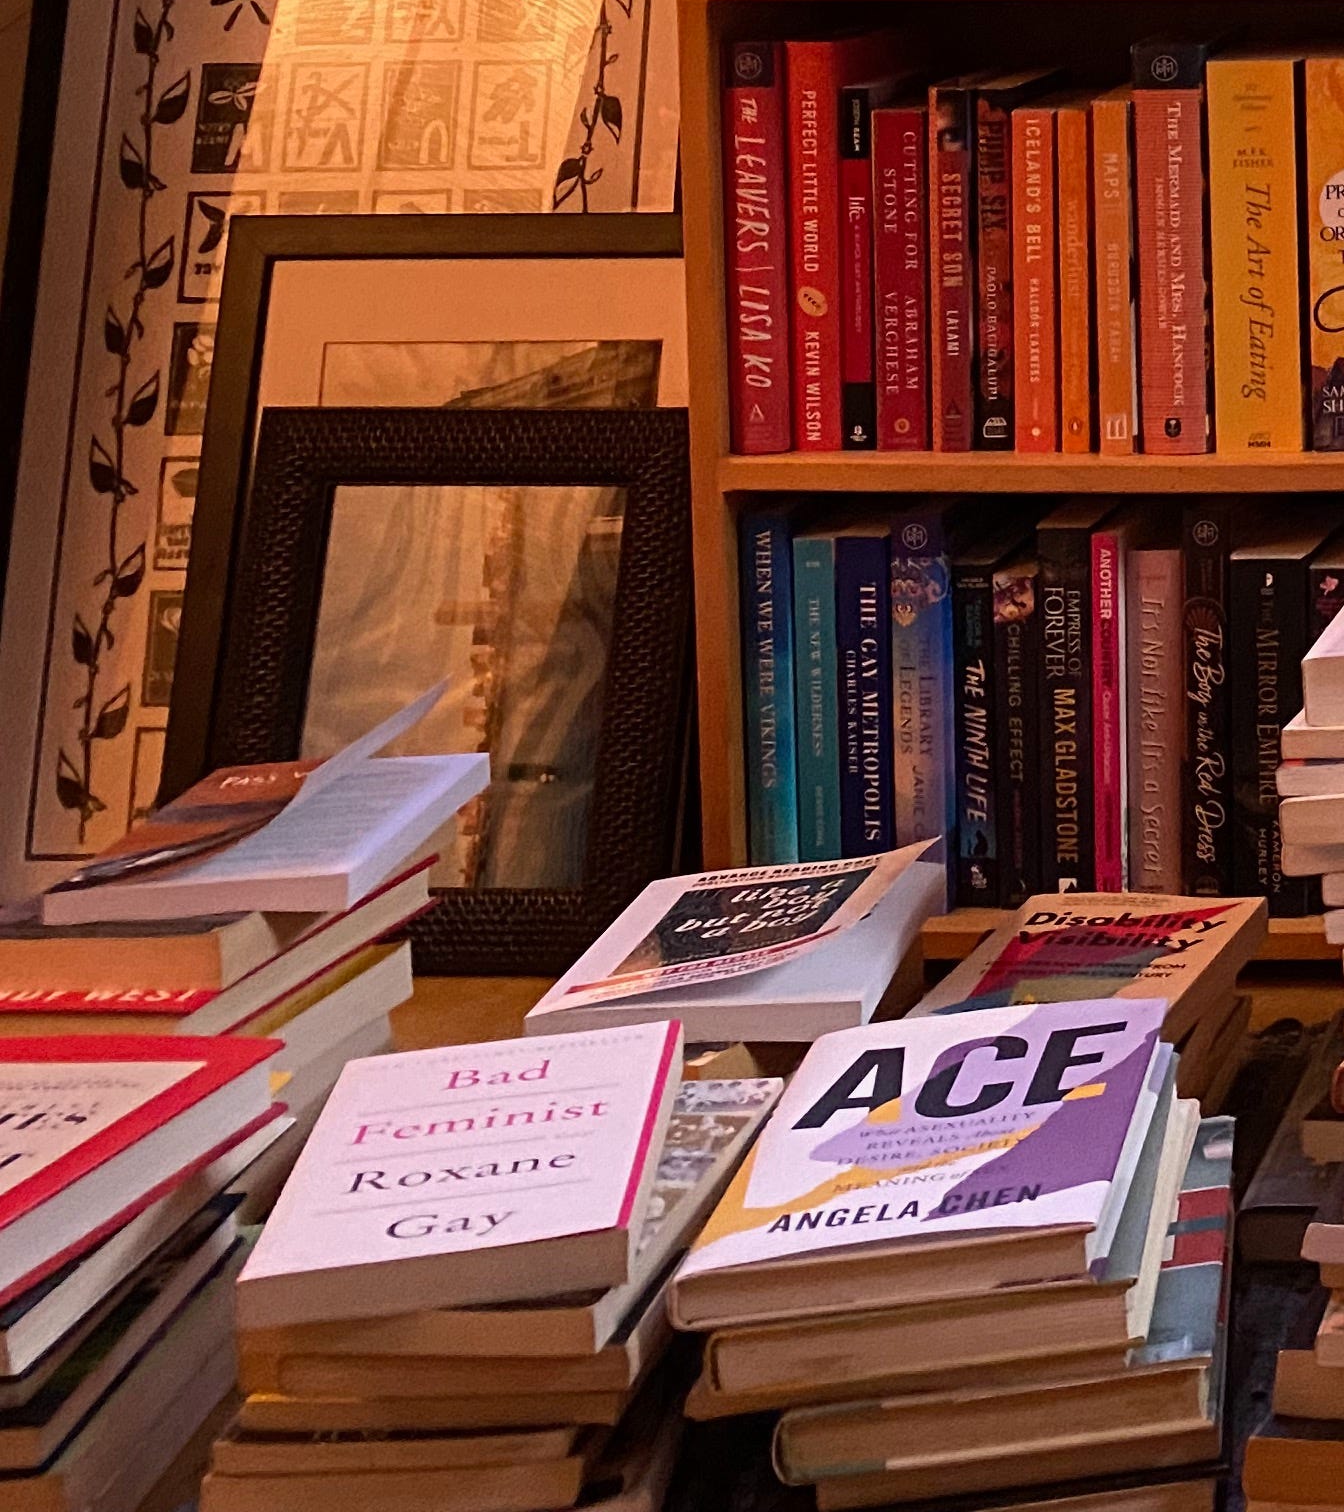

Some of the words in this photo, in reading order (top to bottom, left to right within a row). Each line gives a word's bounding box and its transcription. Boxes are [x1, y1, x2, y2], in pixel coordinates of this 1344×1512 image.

[802, 90, 818, 155] PERFECT
[735, 135, 768, 253] LEAVERS
[802, 162, 818, 212] LITTLE
[1245, 183, 1271, 233] The
[804, 220, 819, 272] WORLD
[1026, 224, 1040, 263] BELL
[1246, 238, 1271, 277] Art
[737, 285, 773, 341] LISA
[1240, 287, 1273, 318] of
[743, 352, 774, 389] KO
[804, 331, 821, 376] KEVIN
[1242, 319, 1274, 400] Eating
[804, 382, 822, 441] WILSON
[859, 583, 876, 630] THE
[859, 637, 877, 681] GAY
[1051, 689, 1075, 731] MAX
[861, 688, 881, 841] METROPOLIS
[1055, 736, 1079, 863] GLADSTONE
[1025, 912, 1227, 933] Disability
[446, 1060, 551, 1090] Bad
[791, 1021, 1128, 1132] ACE
[350, 1097, 610, 1148] Feminist
[346, 1150, 577, 1194] Roxane
[385, 1208, 517, 1240] Gay
[767, 1200, 920, 1234] ANGELA
[939, 1183, 1042, 1217] CHEN
